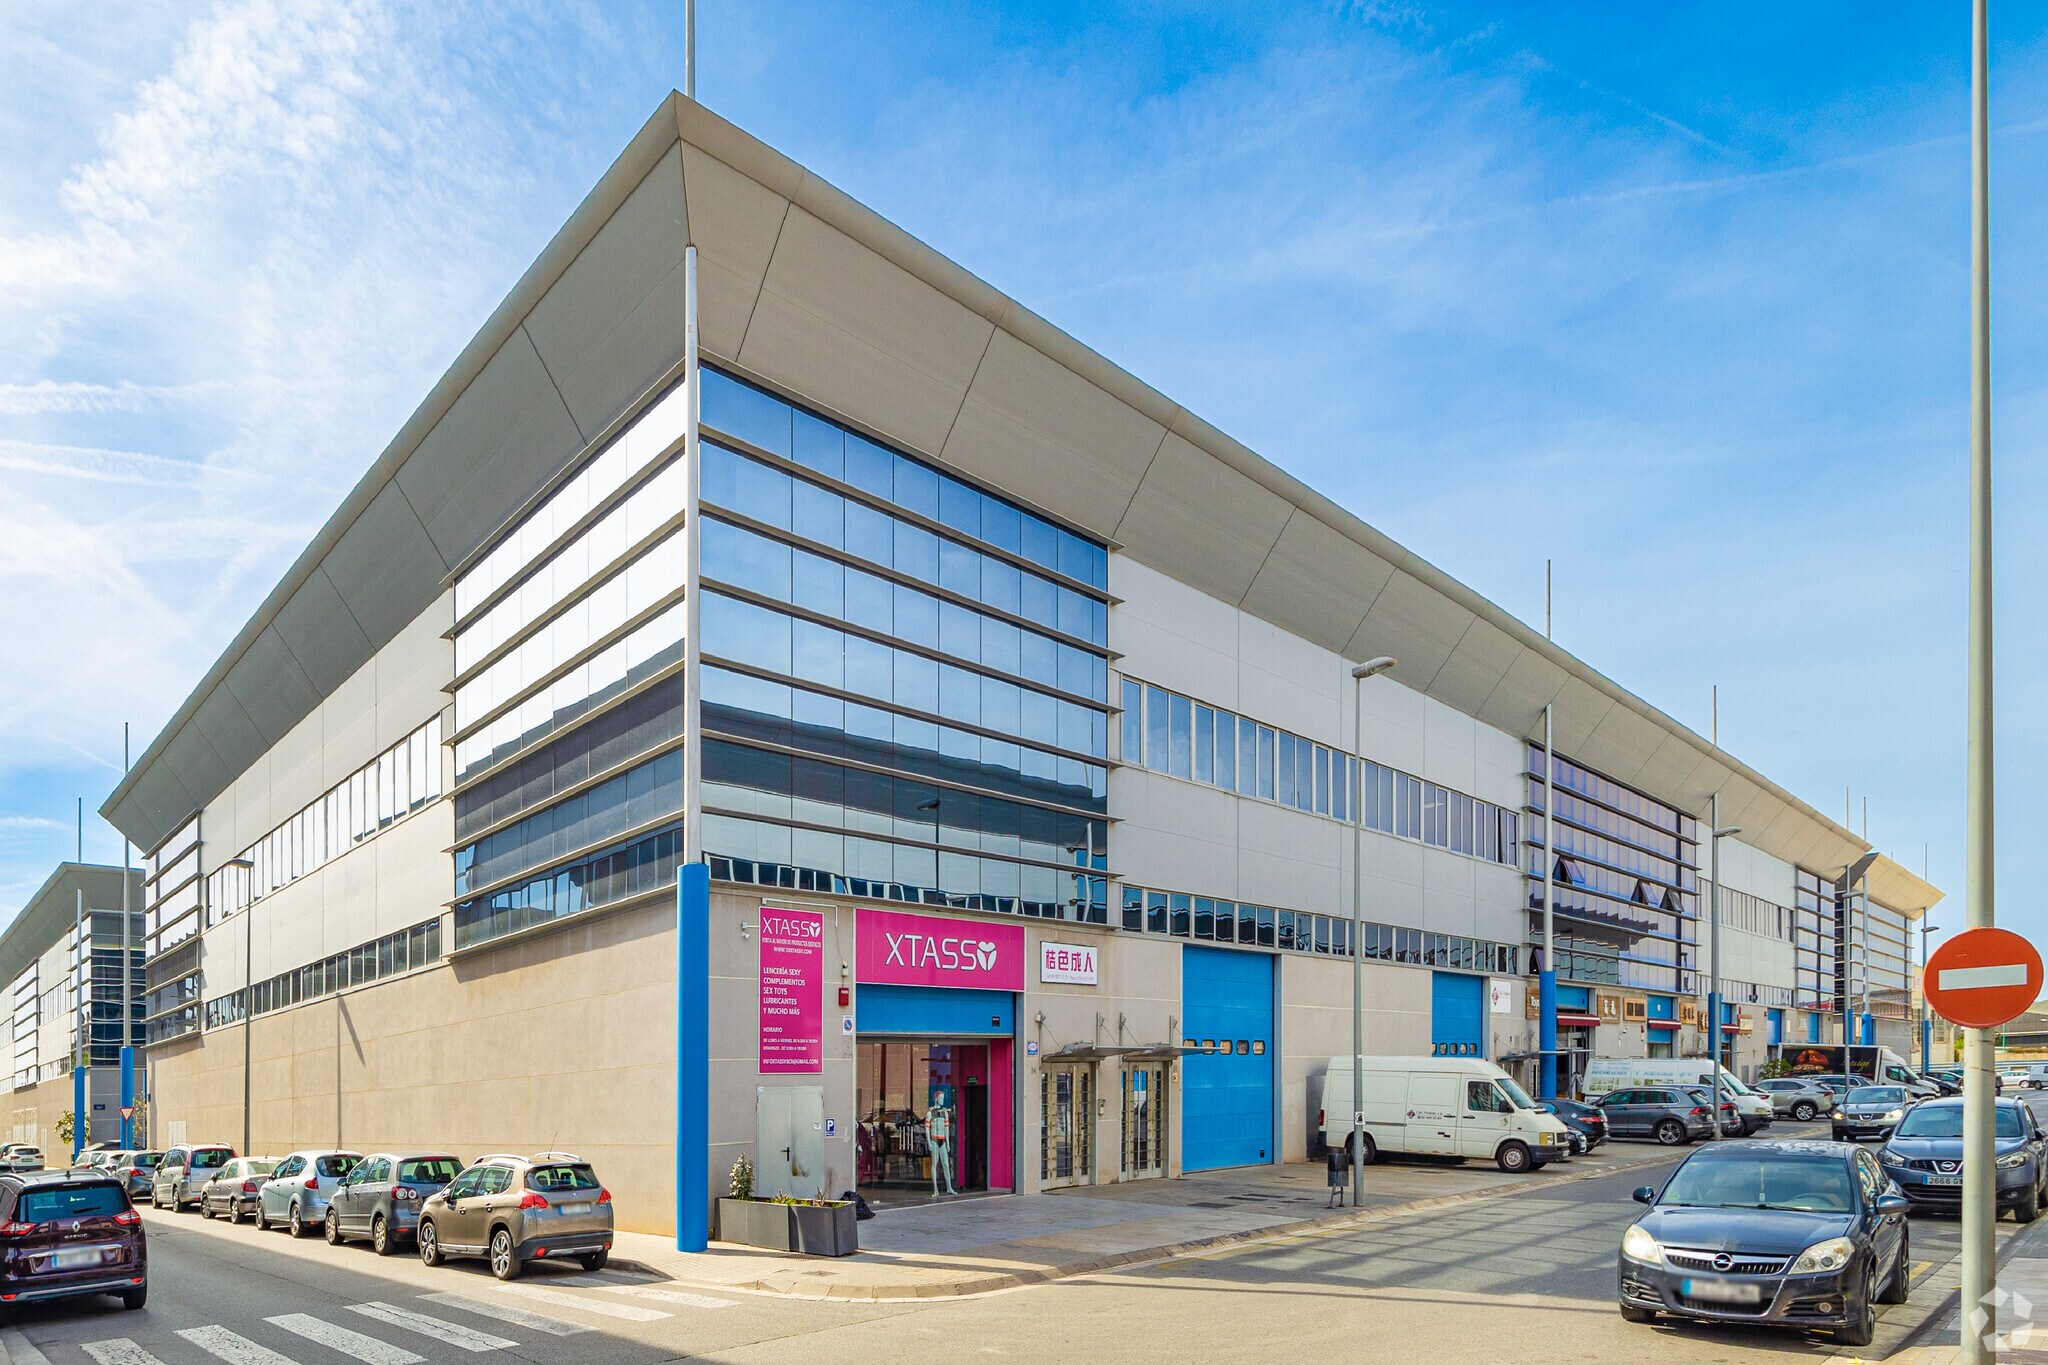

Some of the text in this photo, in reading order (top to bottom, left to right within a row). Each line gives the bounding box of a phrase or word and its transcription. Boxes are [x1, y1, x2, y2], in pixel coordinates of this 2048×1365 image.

[763, 967, 802, 976] LENCERÍA SEXY
[763, 977, 806, 986] COMPLEMENTOS
[763, 986, 788, 995] SEX TOYS
[763, 997, 798, 1005] LUBRICANTES
[768, 1007, 788, 1015] MUCHO
[789, 1006, 801, 1016] MÁS
[827, 1120, 834, 1131] P
